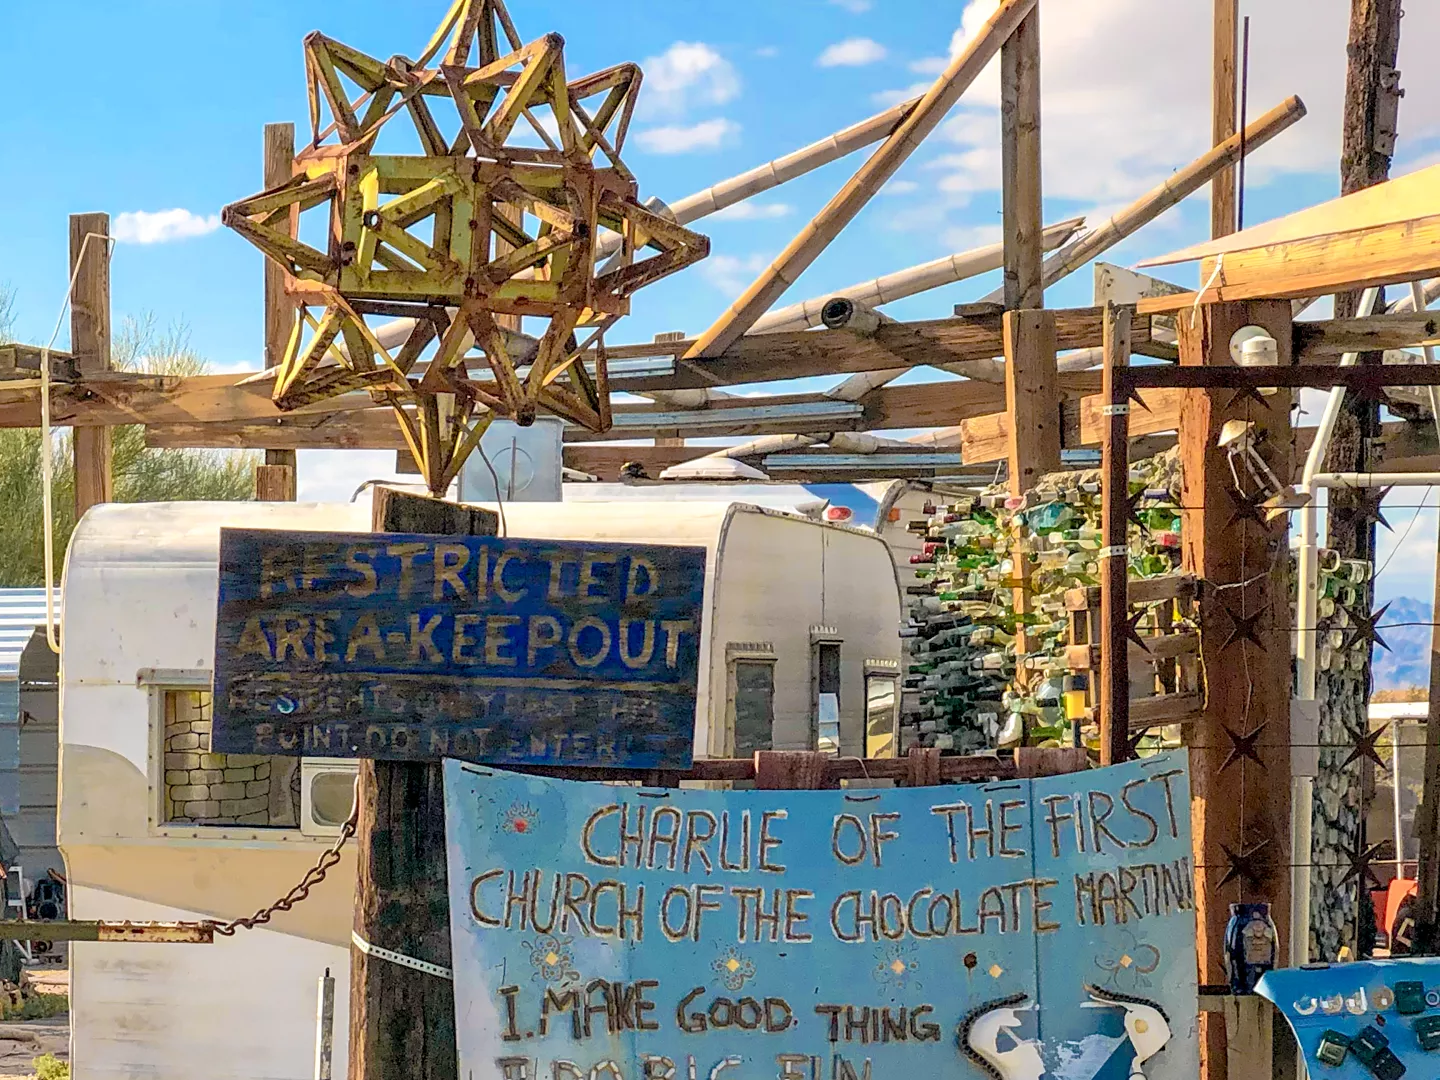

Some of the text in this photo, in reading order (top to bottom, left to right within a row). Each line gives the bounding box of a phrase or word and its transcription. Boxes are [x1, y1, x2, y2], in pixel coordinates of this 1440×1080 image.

[261, 542, 659, 603] RESTRICTED
[428, 726, 494, 758] NOT
[580, 768, 1185, 875] CHARLIE OF THE FIRST
[468, 867, 645, 942] CHURCH
[661, 883, 725, 943] OF
[730, 885, 815, 944] THE
[829, 877, 1062, 943] CHOCOLATE
[539, 977, 661, 1041] MAKE
[813, 1003, 941, 1045] THING
